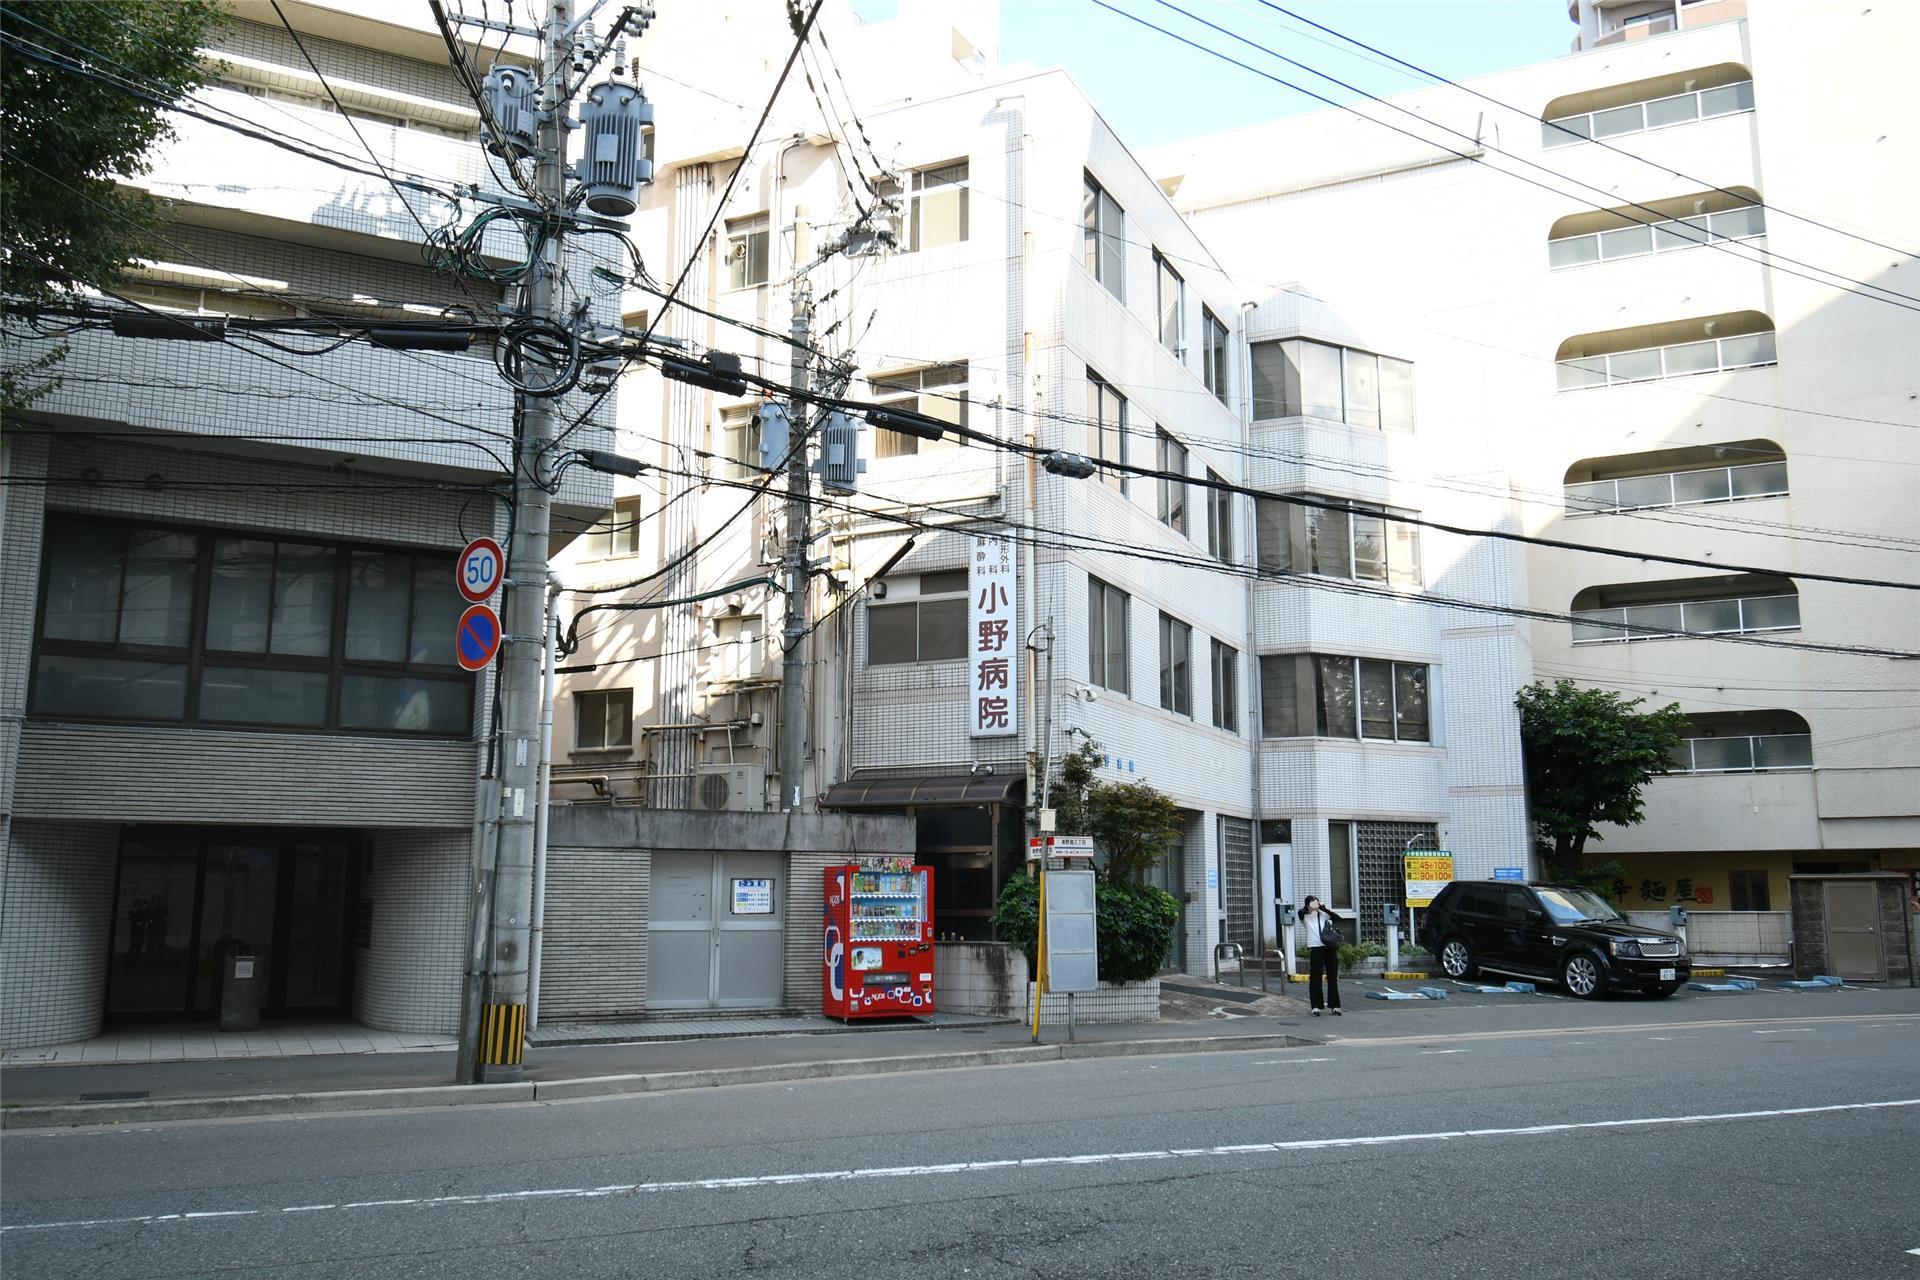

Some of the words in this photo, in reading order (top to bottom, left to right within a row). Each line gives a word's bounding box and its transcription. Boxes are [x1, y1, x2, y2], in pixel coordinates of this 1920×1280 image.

[467, 555, 493, 585] 50
[988, 536, 998, 575] 内科
[977, 581, 1009, 730] 小野病院
